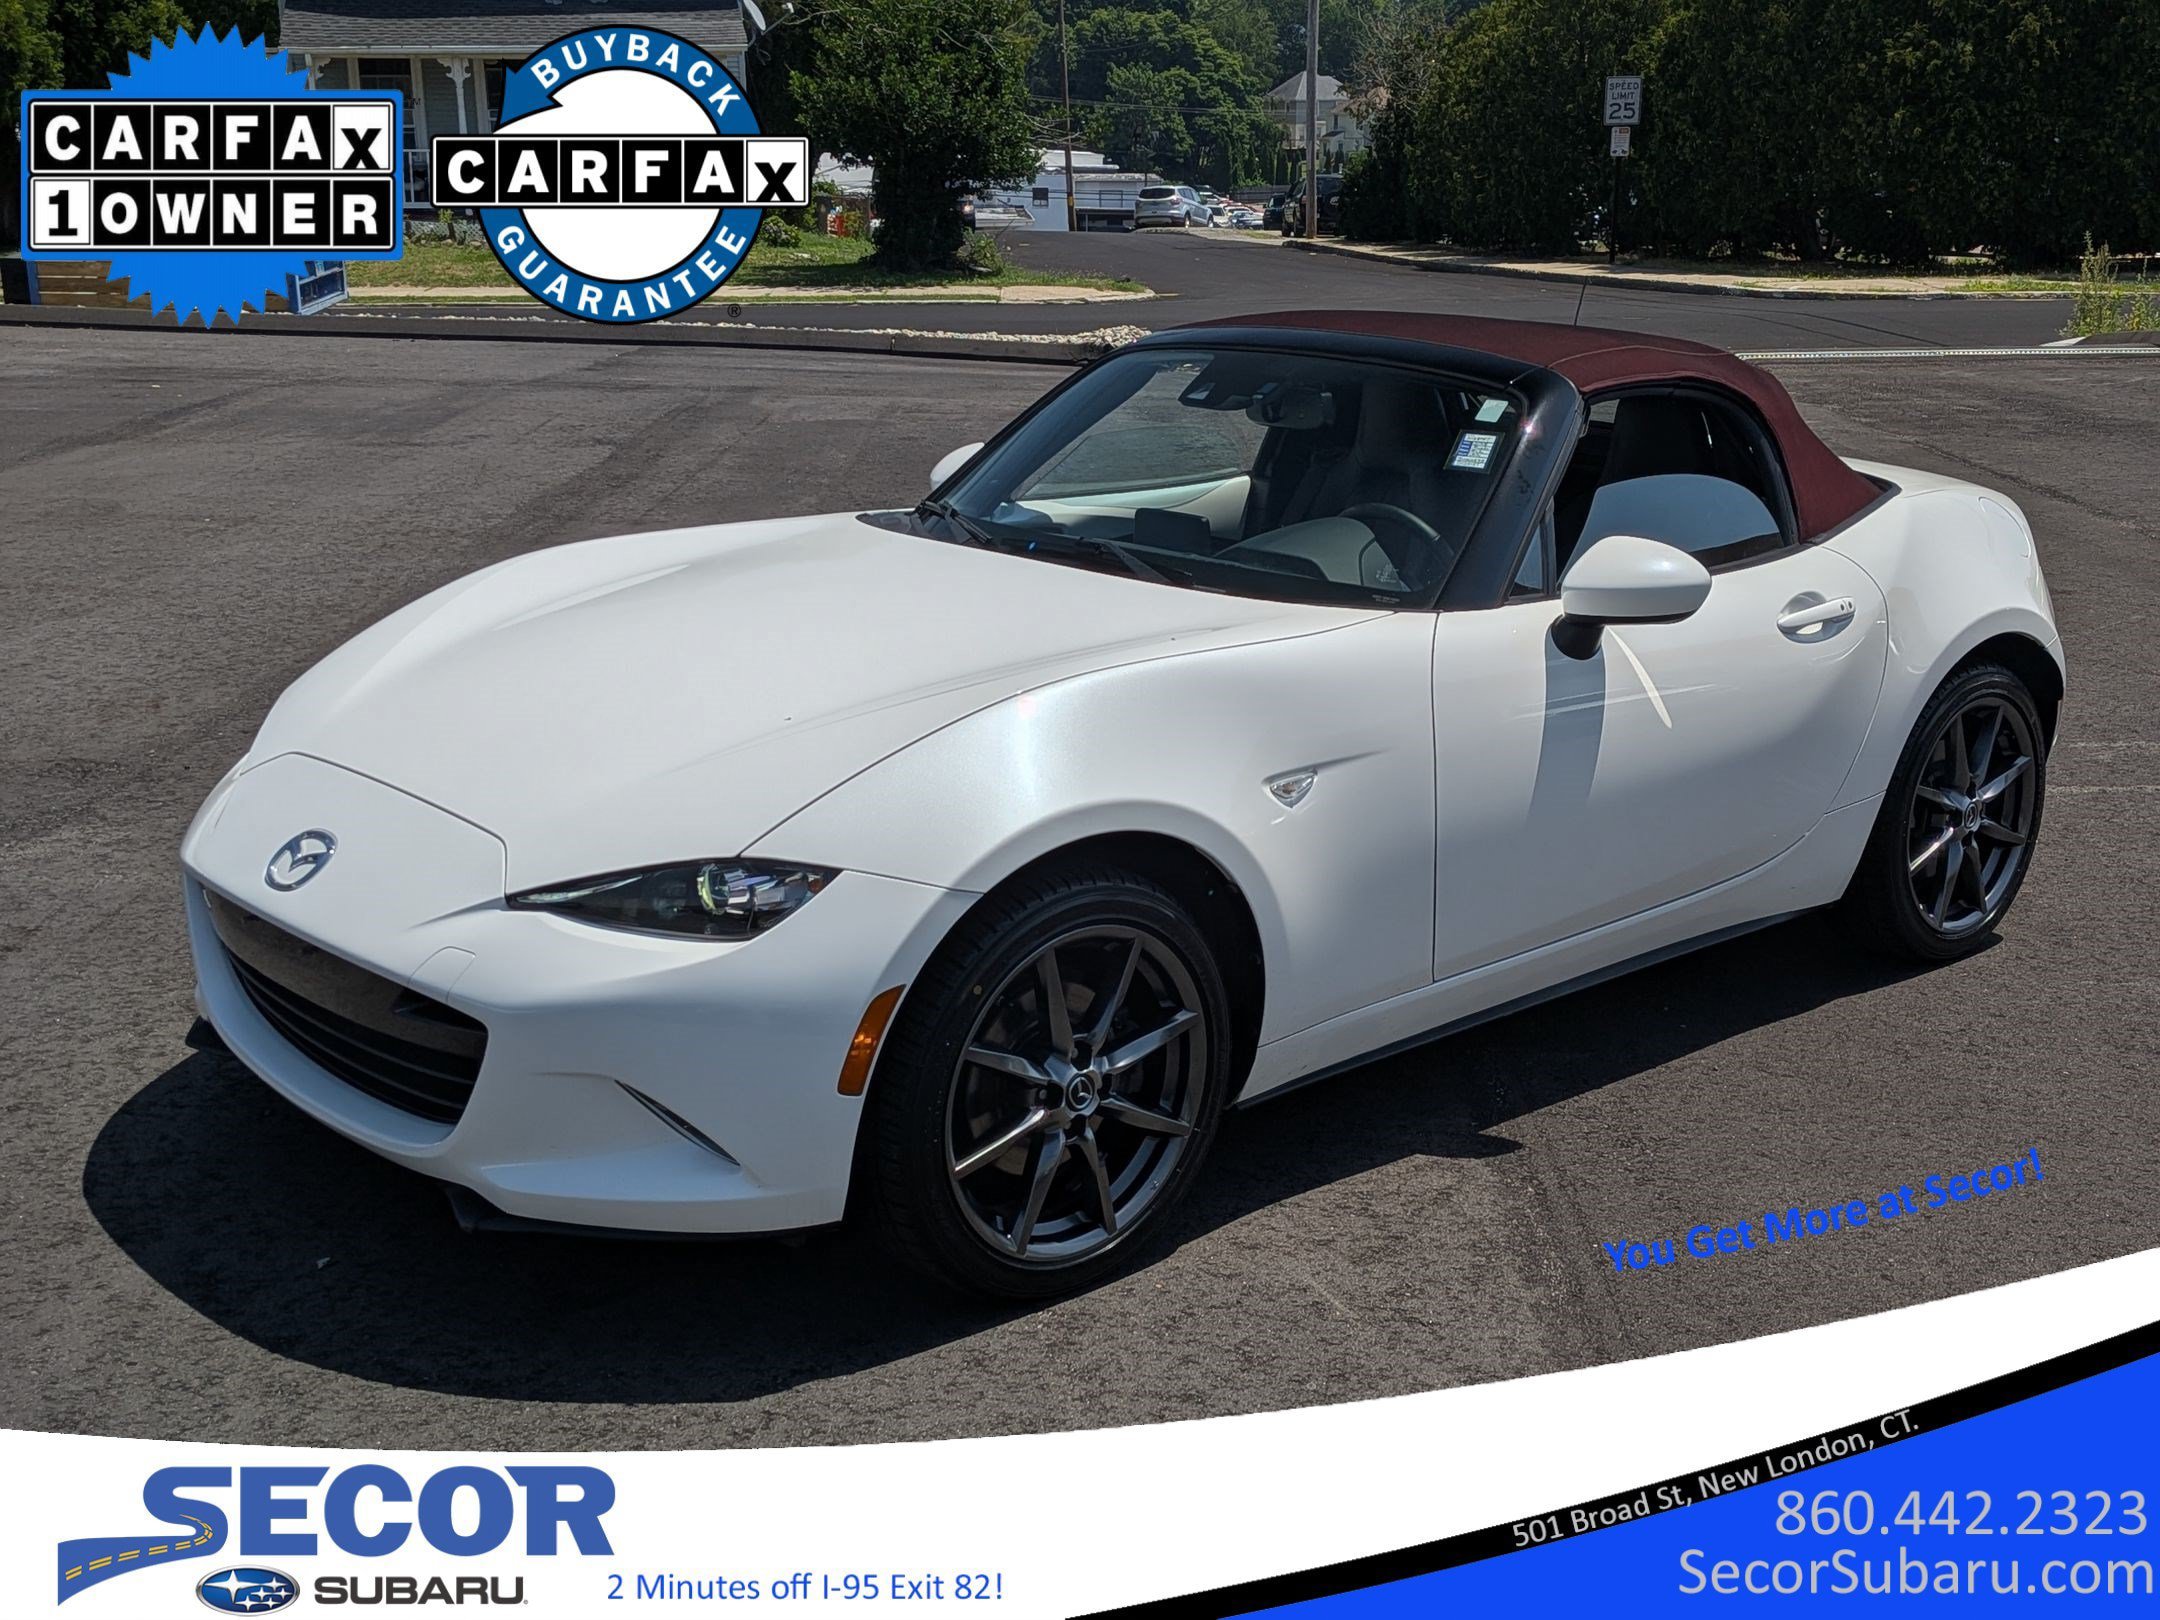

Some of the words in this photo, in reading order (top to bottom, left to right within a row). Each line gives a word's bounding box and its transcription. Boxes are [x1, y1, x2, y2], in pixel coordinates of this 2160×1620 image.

[1609, 82, 1639, 90] SPEED
[1612, 92, 1635, 100] LIMIT
[1609, 102, 1636, 120] 25
